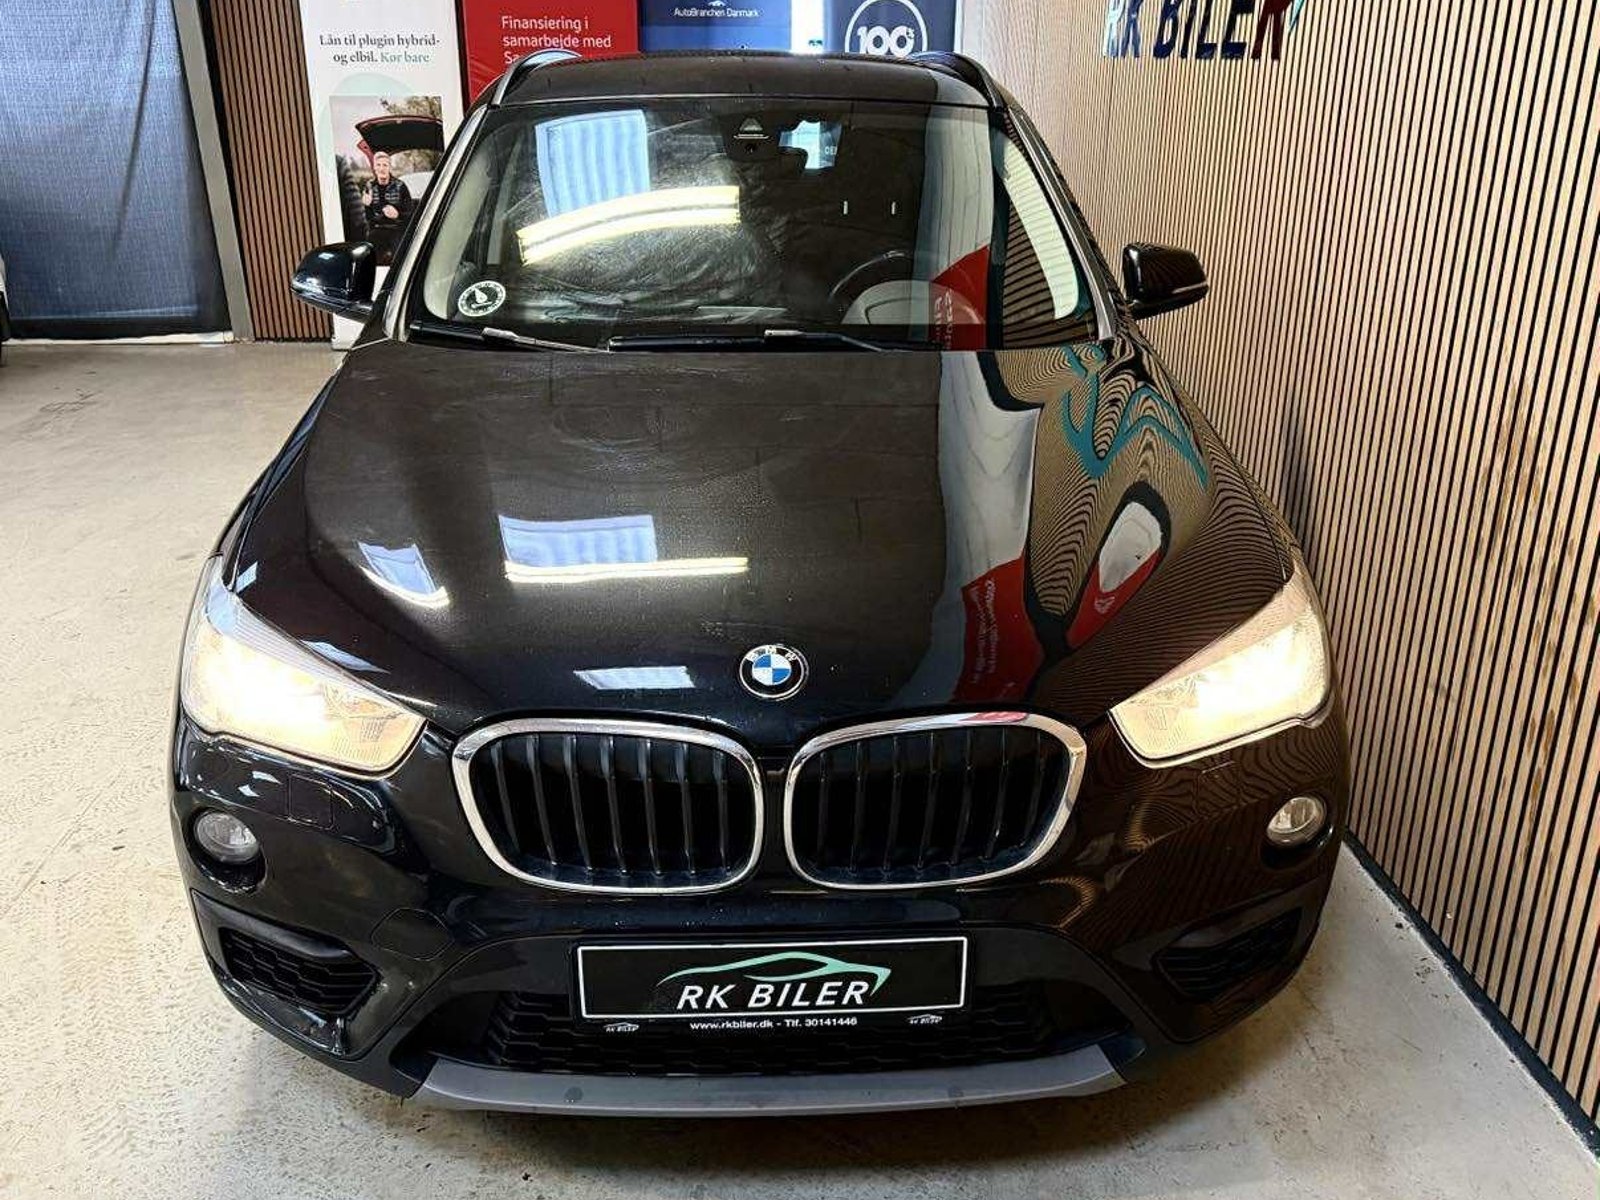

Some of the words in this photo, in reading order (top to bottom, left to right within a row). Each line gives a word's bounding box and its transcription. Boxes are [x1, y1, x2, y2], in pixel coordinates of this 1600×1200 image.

[726, 7, 759, 17] Danmark
[501, 15, 582, 33] Finansiering
[584, 15, 589, 29] i
[320, 34, 341, 45] Lån
[344, 33, 356, 45] til
[359, 33, 395, 48] plugin
[397, 33, 440, 48] hybrid-
[503, 34, 580, 50] samarbejde
[583, 35, 612, 47] med
[333, 54, 348, 66] og
[350, 51, 378, 62] elbil.
[404, 51, 431, 62] bare
[677, 984, 735, 1010] RK
[747, 981, 869, 1008] BILER
[690, 1020, 774, 1030] www.rkbiler.dk
[784, 1018, 802, 1028] Tlf.
